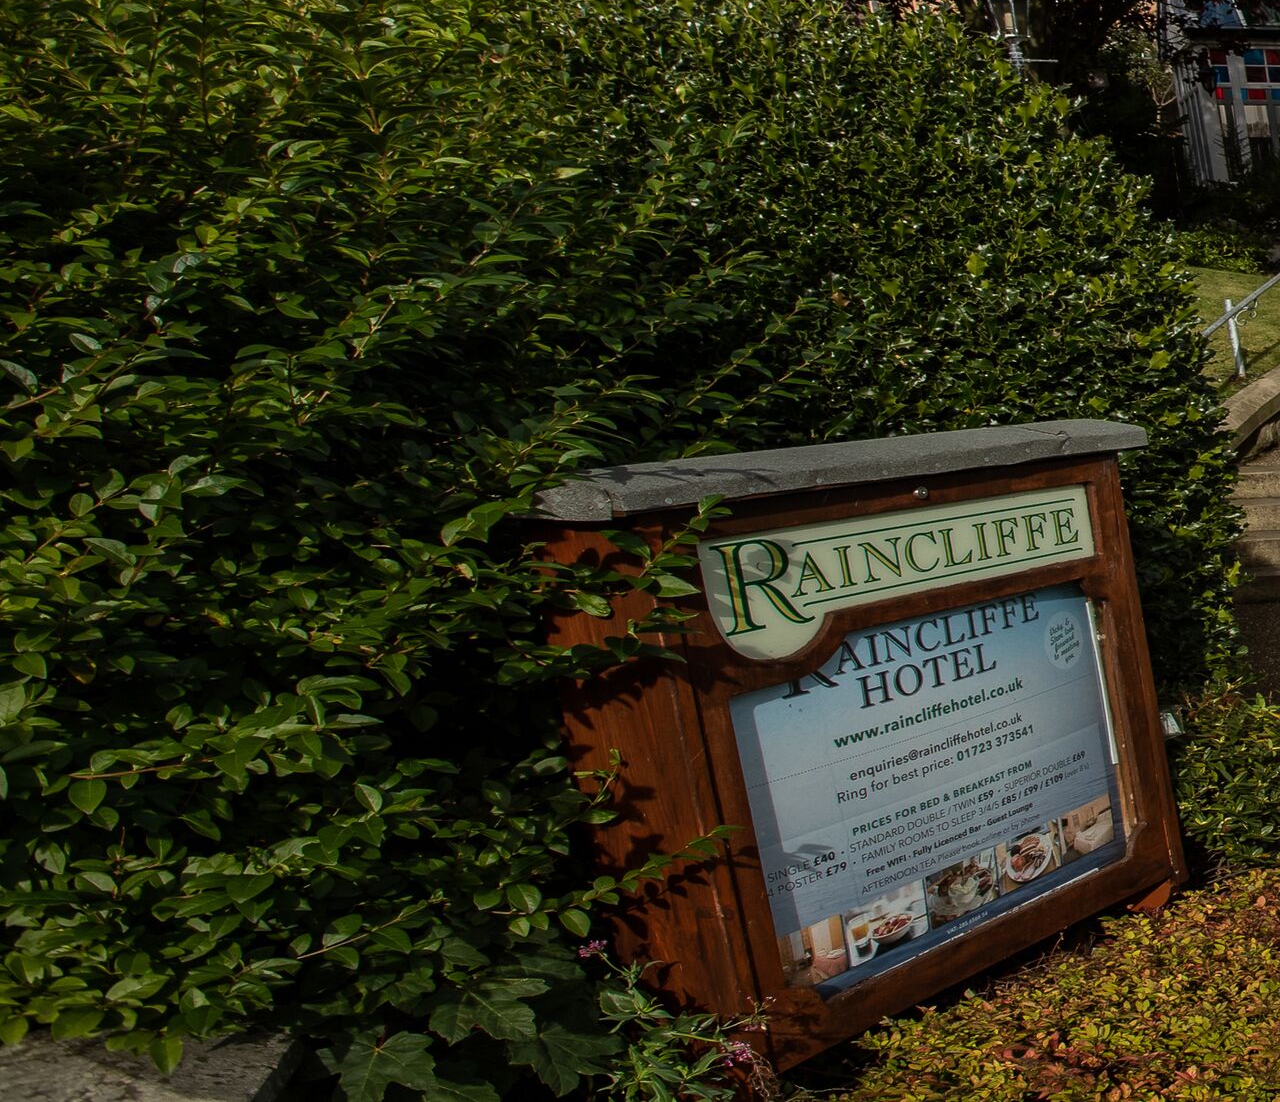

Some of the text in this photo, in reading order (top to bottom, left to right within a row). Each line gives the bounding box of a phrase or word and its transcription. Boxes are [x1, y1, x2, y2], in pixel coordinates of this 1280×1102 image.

[709, 507, 1079, 637] RAINCLIFFE
[833, 677, 1024, 748] www.raincliffehotel.co.uk
[856, 643, 997, 709] HOTEL
[837, 724, 1034, 804] Ring for best price: 01723 373541
[849, 712, 1023, 782] enquiries@raincliffehotel.co.uk
[767, 860, 810, 883] SINGLE
[813, 851, 835, 866] £40
[849, 825, 905, 853] STANDARD
[907, 809, 946, 832] DOUBLE
[953, 797, 976, 813] TWIN
[978, 790, 994, 803] £59
[1004, 771, 1042, 792] SUPERIOR
[1042, 757, 1071, 776] DOUBLE
[1072, 750, 1086, 763] £69
[778, 870, 823, 895] POSTER
[825, 861, 847, 877] £79
[861, 842, 897, 863] FAMILY
[898, 827, 935, 848] ROOMS
[937, 821, 950, 833] TO
[951, 809, 977, 827] SLEEP
[978, 801, 1000, 816] 3/4/5
[1001, 793, 1017, 806] £85
[1023, 784, 1039, 797] £99
[1045, 773, 1064, 788] £109
[852, 760, 1033, 836] PRICES FOR BED & BREAKFAST FROM
[862, 864, 919, 895] AFTERNOON
[920, 858, 937, 869] TEA
[937, 847, 961, 863] Please
[962, 841, 980, 852] book
[1020, 814, 1041, 827] phone
[866, 802, 1034, 877] Free WIFI Fully Licenced Bar Guest Lounge
